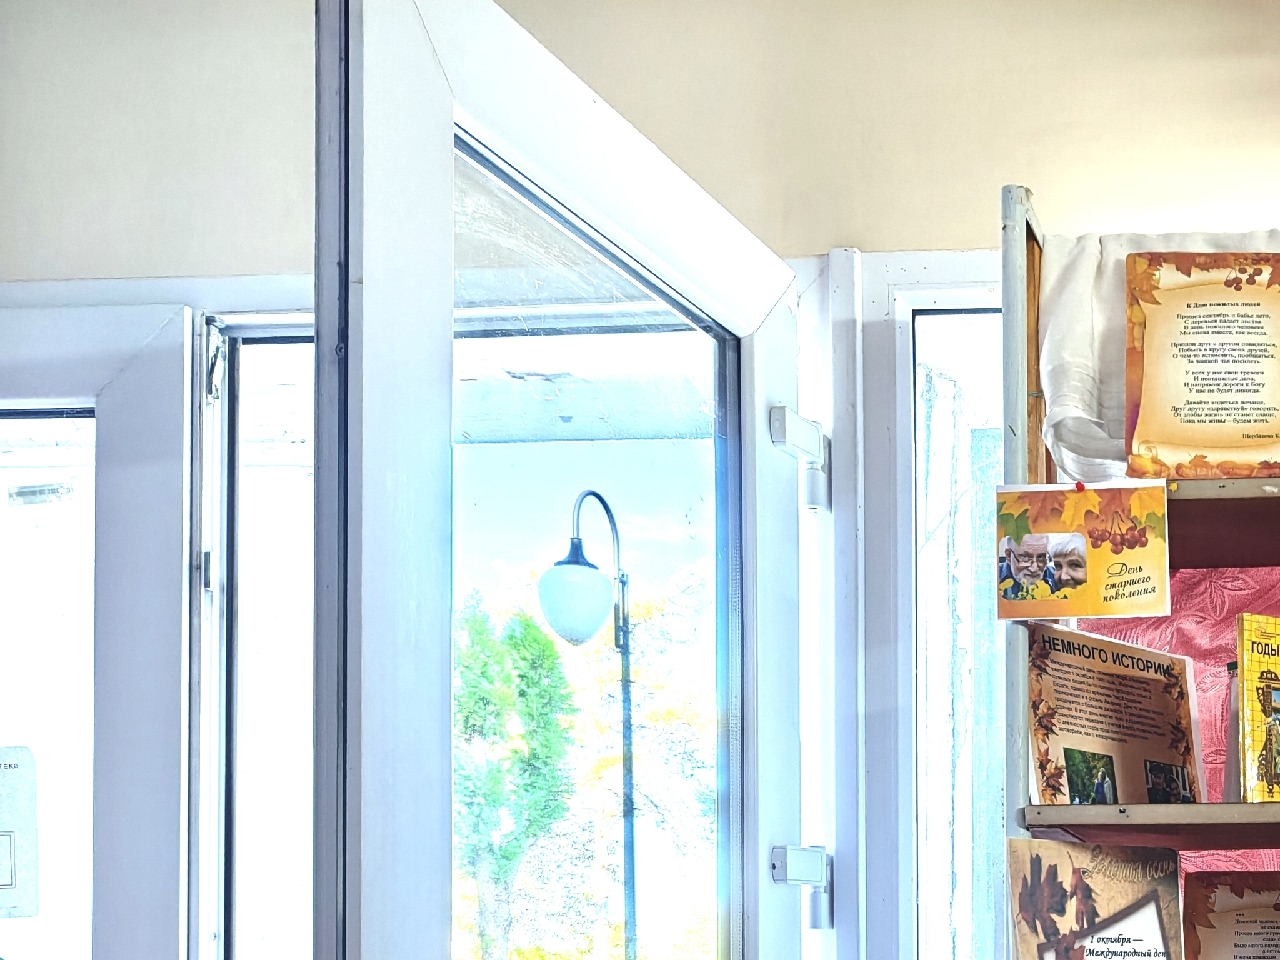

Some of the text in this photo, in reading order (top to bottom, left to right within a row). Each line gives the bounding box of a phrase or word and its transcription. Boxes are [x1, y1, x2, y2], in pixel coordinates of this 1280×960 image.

[1107, 562, 1143, 579] День
[1105, 575, 1151, 590] старшего
[1103, 586, 1156, 603] поколения
[1042, 634, 1172, 677] НЕМНОГО ИСТОРИИ
[1251, 641, 1280, 658] ГОДЫ
[1096, 934, 1131, 944] октября
[1086, 948, 1152, 959] Международный
